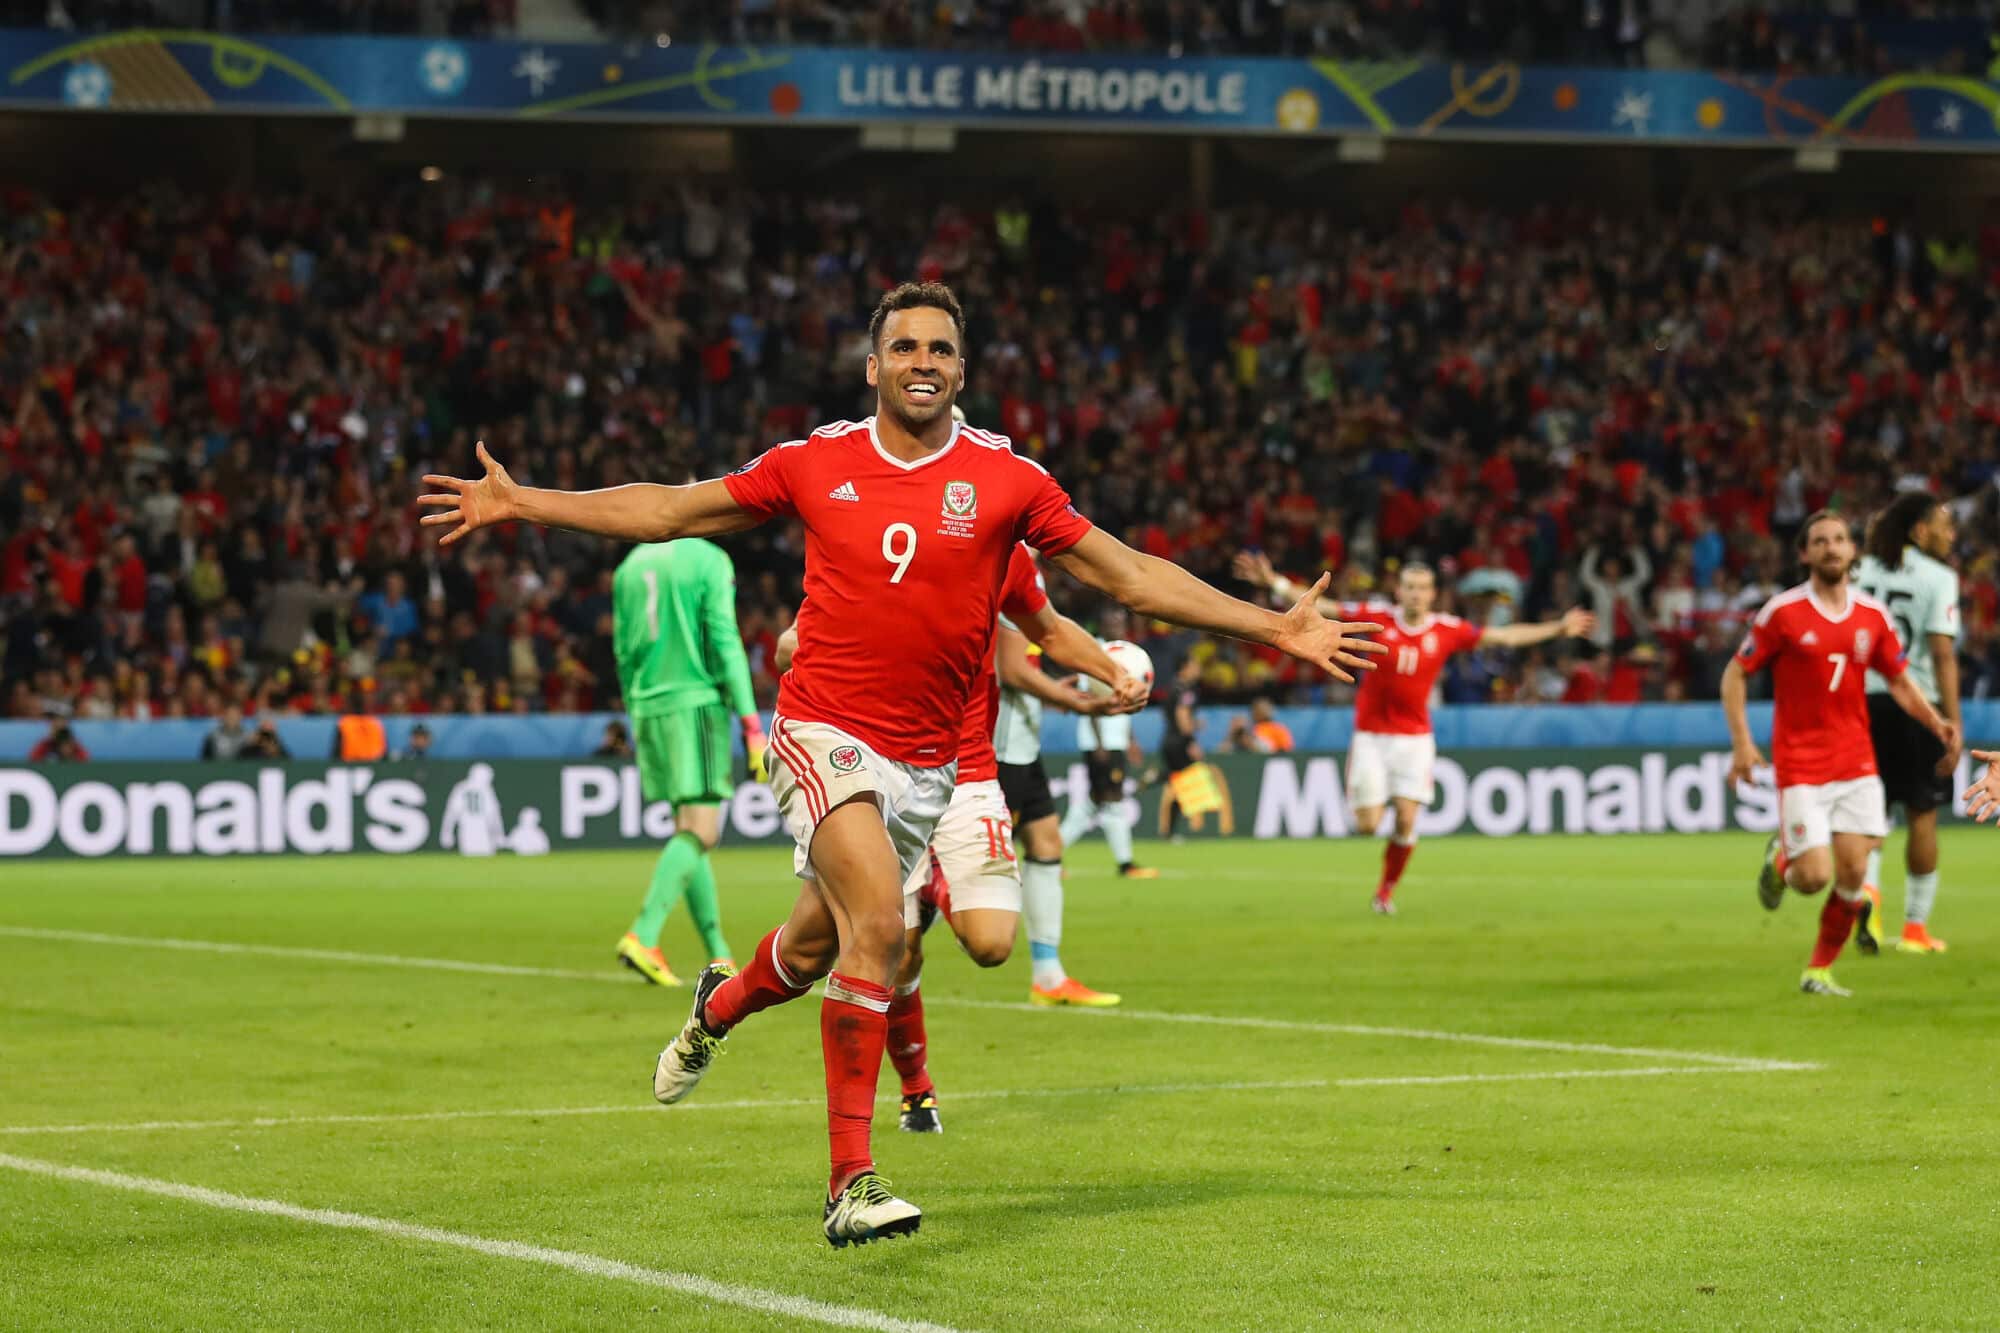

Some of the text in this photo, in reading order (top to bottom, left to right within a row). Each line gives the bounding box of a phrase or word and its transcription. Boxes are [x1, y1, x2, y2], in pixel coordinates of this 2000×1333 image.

[838, 58, 1248, 114] LILLE MÉTROPOLE
[829, 491, 860, 502] adidas
[882, 522, 918, 584] 9
[643, 570, 659, 641] 1
[1397, 645, 1419, 676] 11
[1827, 652, 1848, 693] 7
[0, 767, 430, 856] Donald's
[1253, 751, 1781, 839] MDonald's
